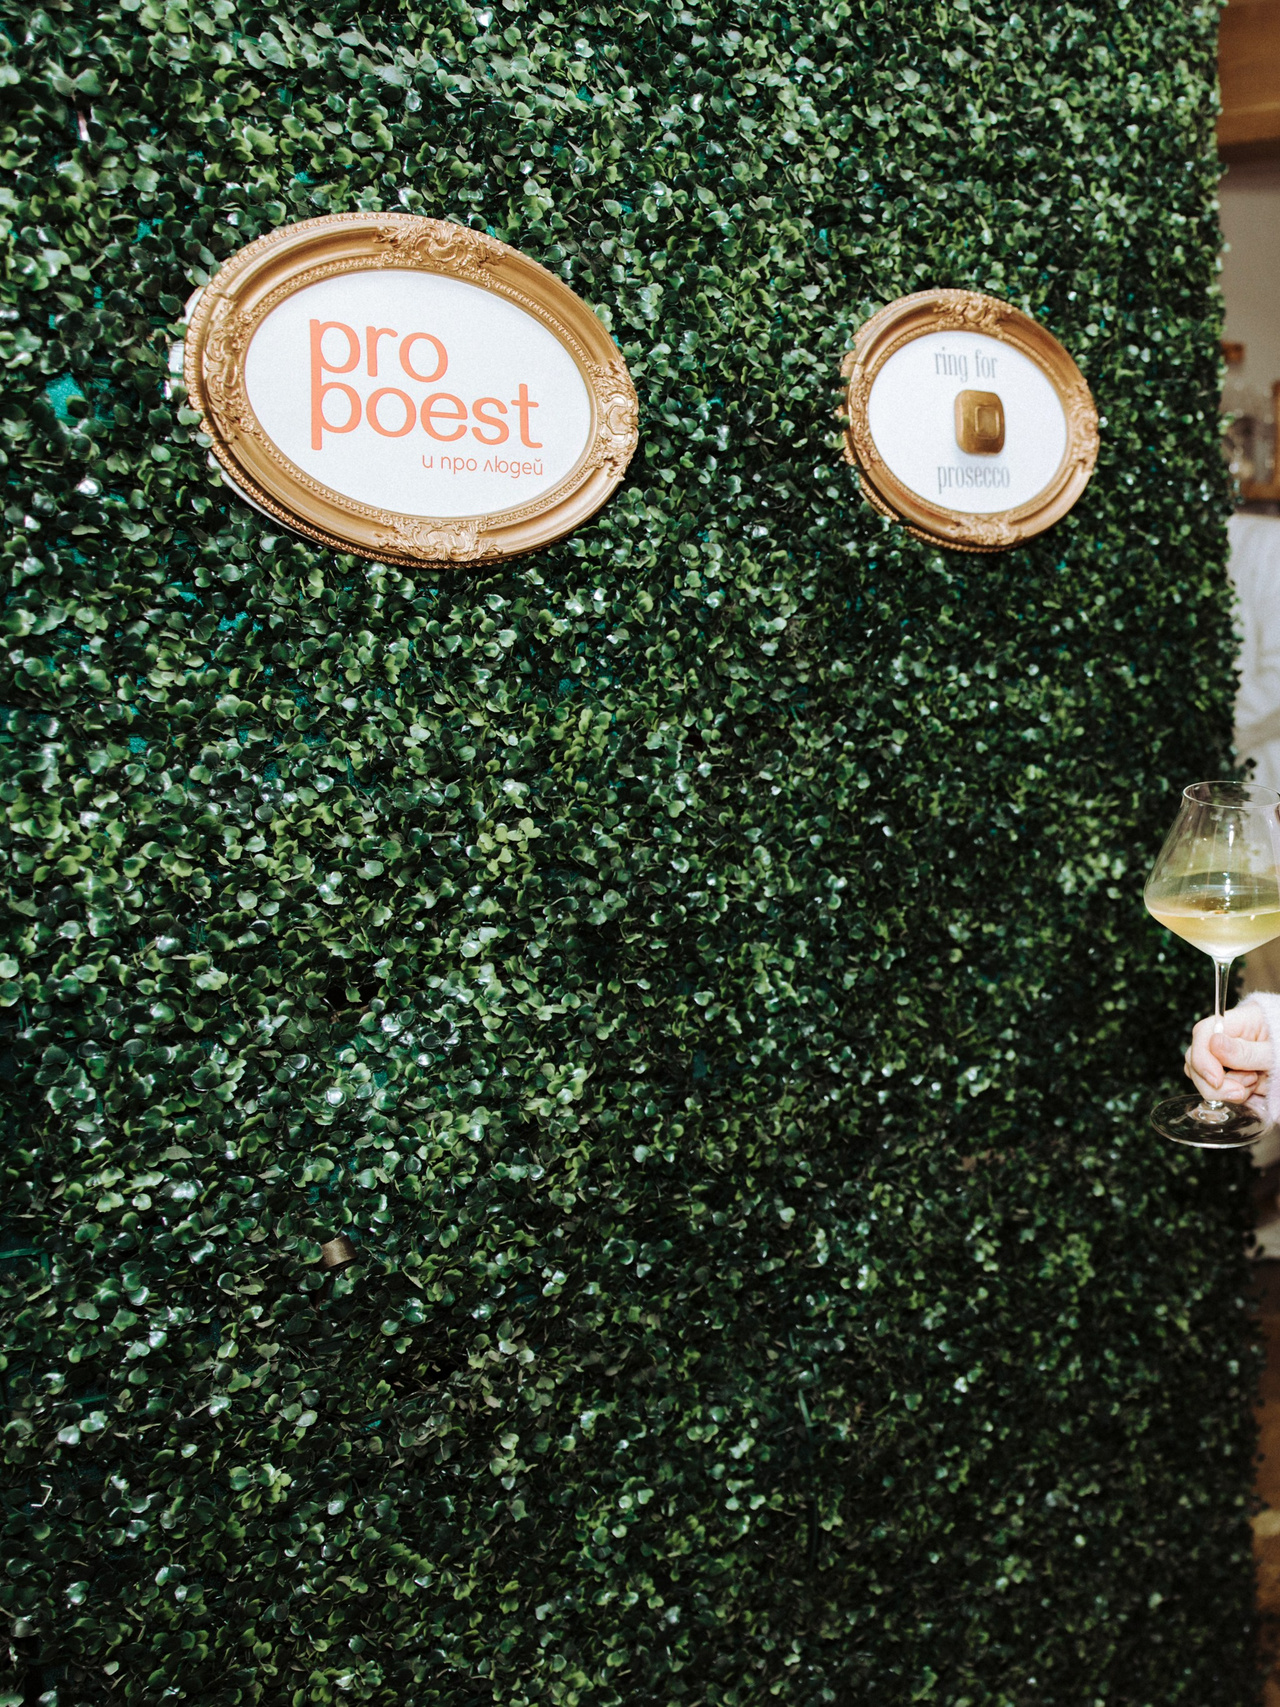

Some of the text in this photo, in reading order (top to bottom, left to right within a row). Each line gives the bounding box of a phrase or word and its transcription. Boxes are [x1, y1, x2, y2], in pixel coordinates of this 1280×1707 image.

[310, 319, 448, 382] pro
[934, 347, 998, 383] ring for
[310, 382, 543, 450] poest
[422, 455, 543, 479] и про людей
[937, 466, 1010, 494] prosecco
